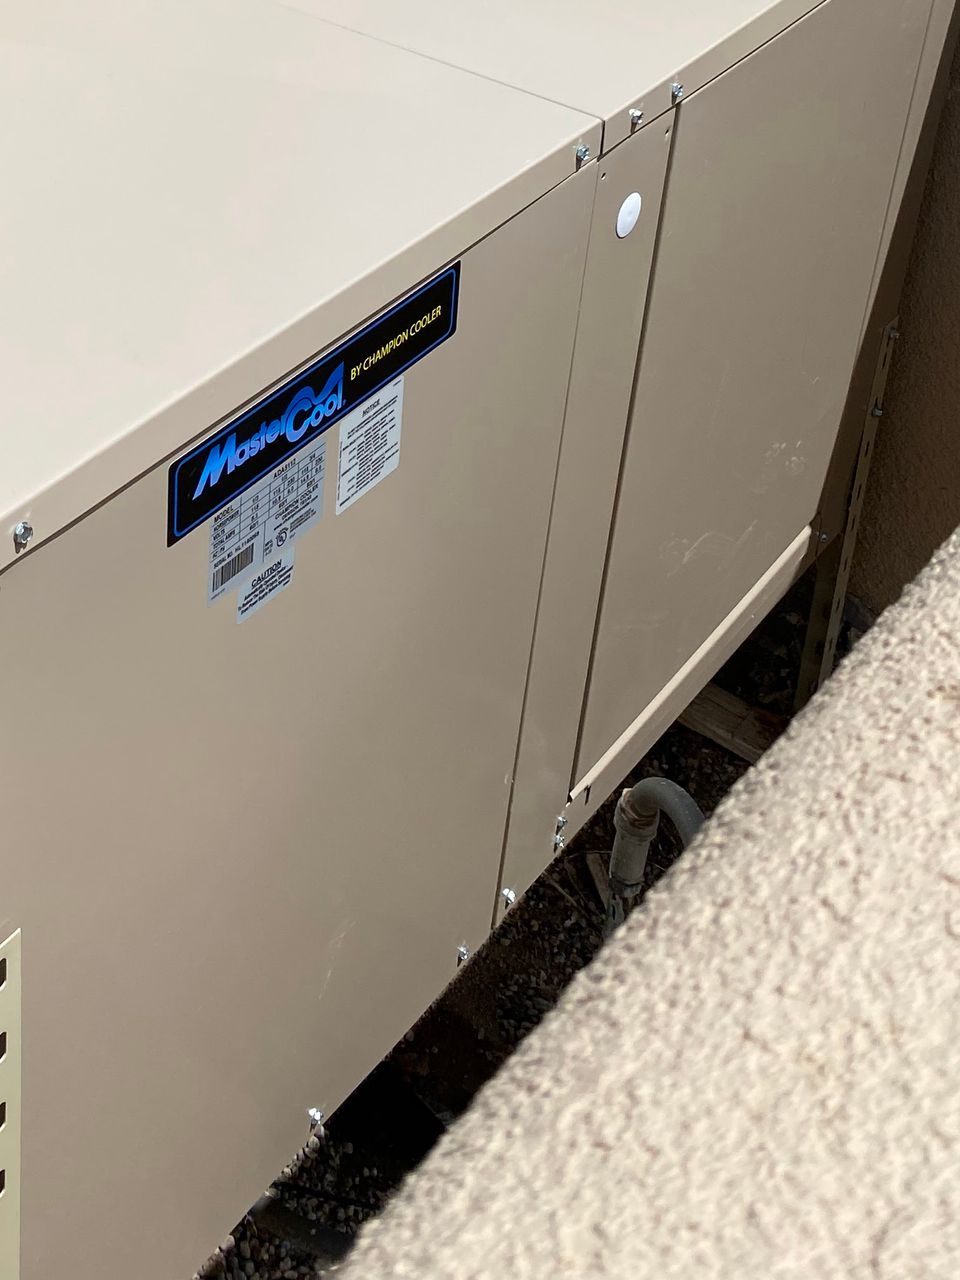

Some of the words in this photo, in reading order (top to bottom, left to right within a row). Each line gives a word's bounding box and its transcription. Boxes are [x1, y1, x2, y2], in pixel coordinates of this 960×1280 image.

[350, 363, 362, 381] BY
[363, 329, 409, 371] CHAMPION
[409, 305, 442, 337] COOLER
[362, 398, 380, 417] NOTICE
[214, 505, 234, 524] MODEL
[251, 558, 282, 588] CAUTION
